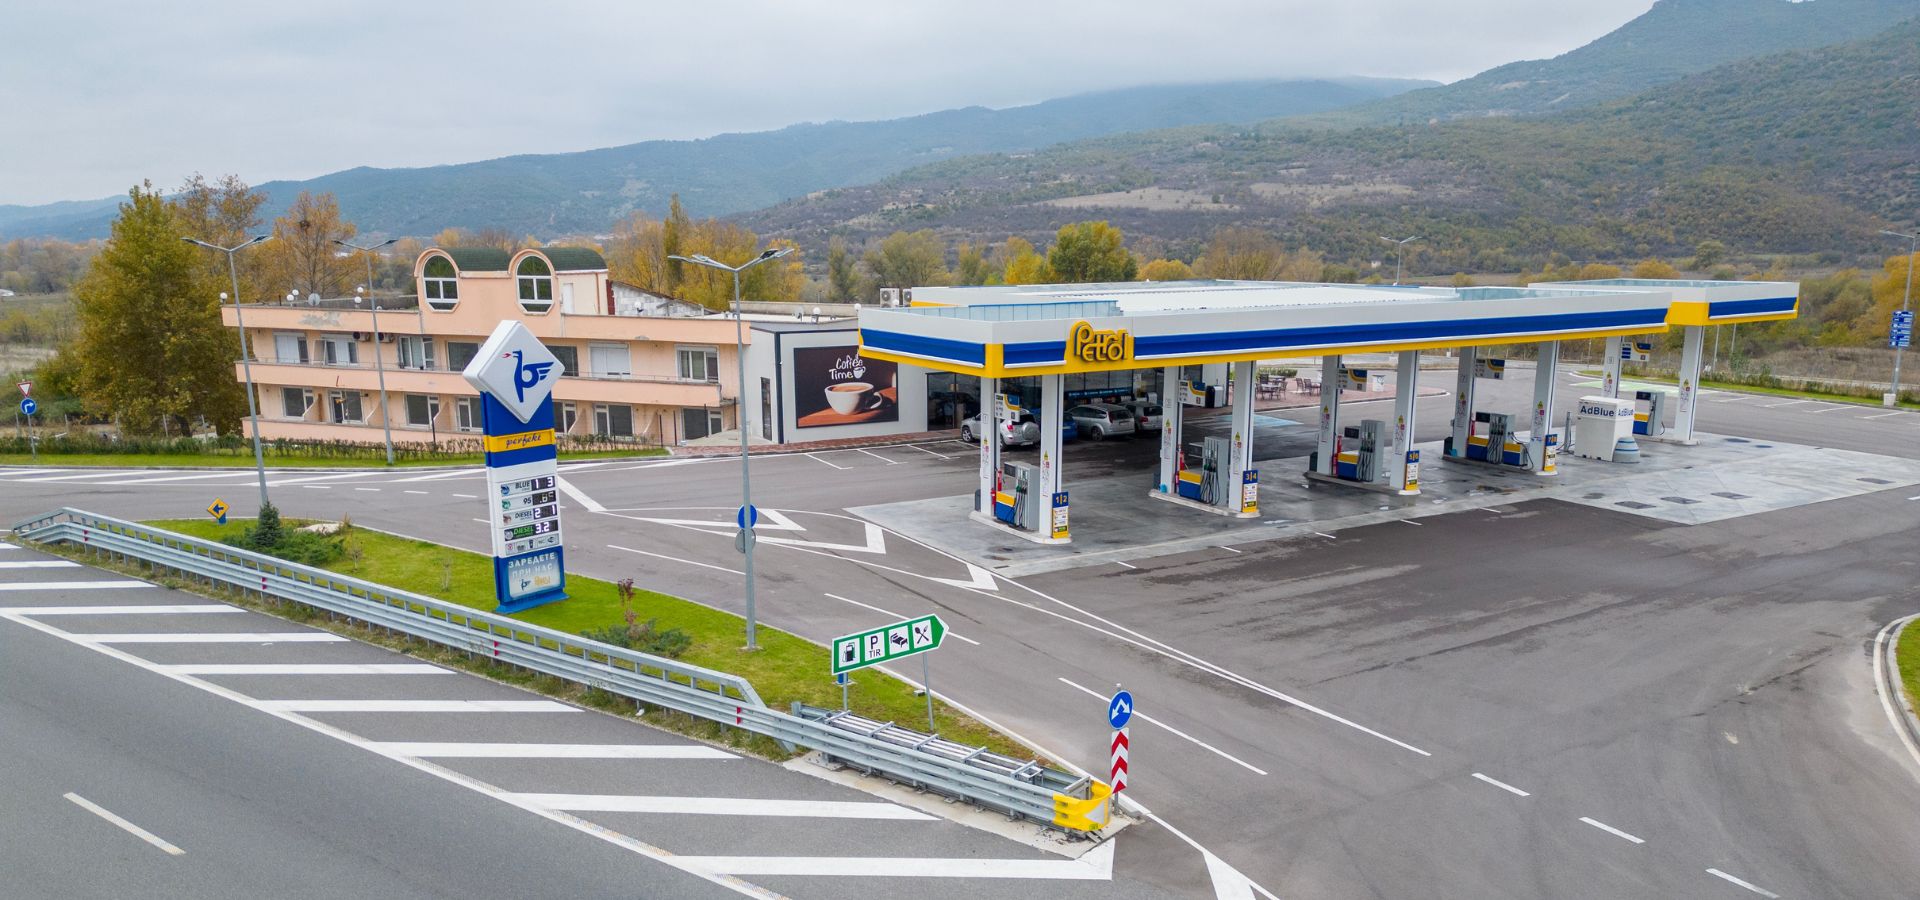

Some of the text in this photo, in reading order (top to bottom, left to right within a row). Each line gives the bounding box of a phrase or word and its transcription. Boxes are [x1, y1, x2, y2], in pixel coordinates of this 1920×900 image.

[1074, 324, 1129, 362] Petrol
[836, 354, 863, 370] Coffee
[829, 368, 853, 380] Time
[1580, 405, 1615, 417] AdBlue
[515, 481, 530, 489] BLUE
[513, 526, 534, 535] DIESEL
[509, 552, 555, 568] ЗАРЕДЕТЕ
[512, 567, 531, 578] ПРИ
[871, 635, 878, 649] P
[869, 649, 881, 658] TIR
